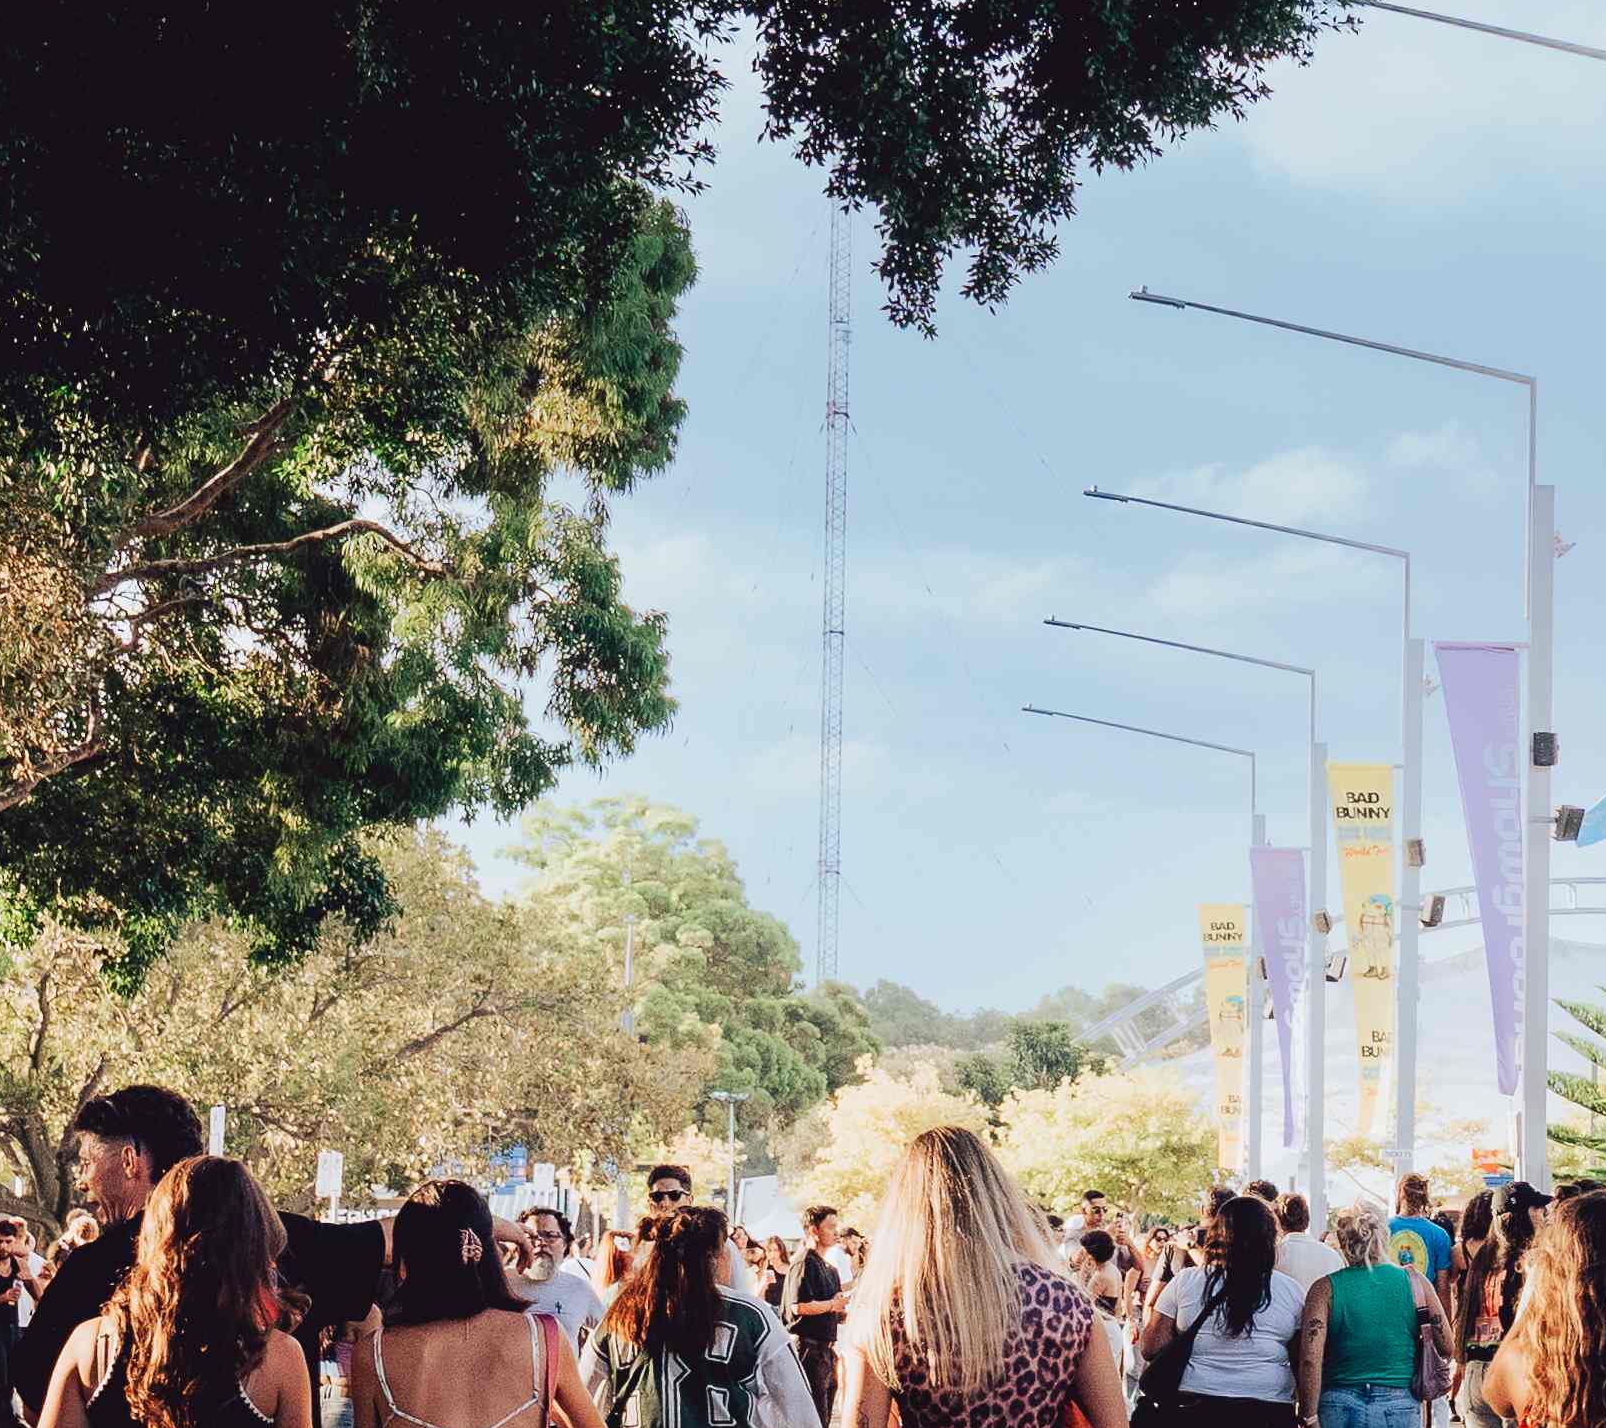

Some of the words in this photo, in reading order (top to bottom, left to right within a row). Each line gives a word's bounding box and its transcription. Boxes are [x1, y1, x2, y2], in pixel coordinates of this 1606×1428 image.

[1346, 791, 1379, 803] BAD
[1336, 807, 1390, 819] BUNNY
[1210, 921, 1235, 931] BAD
